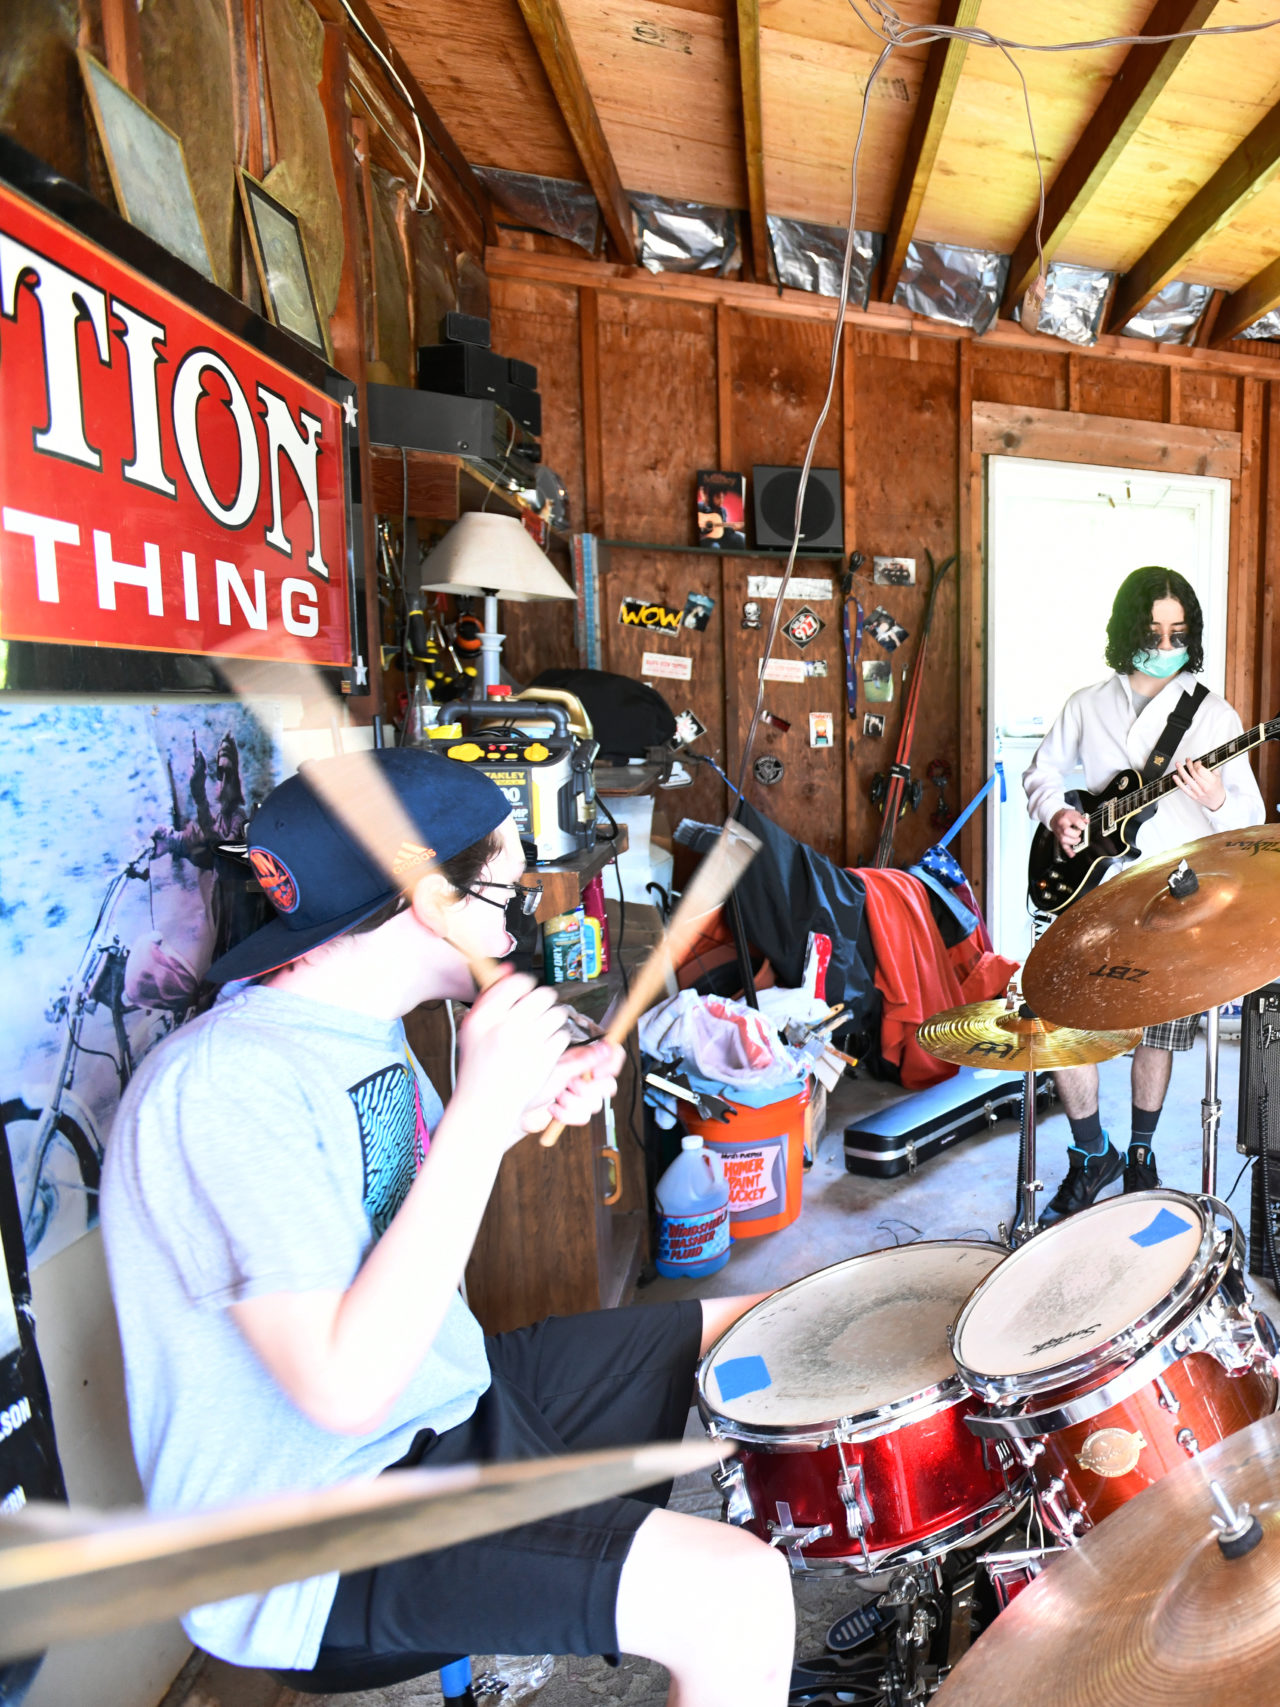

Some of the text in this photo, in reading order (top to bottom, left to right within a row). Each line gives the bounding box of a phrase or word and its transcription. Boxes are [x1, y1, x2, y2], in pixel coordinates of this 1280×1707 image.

[3, 507, 319, 638] THING
[484, 771, 525, 779] TANLEY
[392, 849, 437, 874] adidas
[1089, 964, 1150, 983] ZBT
[724, 1158, 765, 1178] HOMER
[728, 1173, 762, 1191] PAINT
[729, 1186, 767, 1203] UCKET
[669, 1230, 716, 1249] WASHER
[670, 1246, 704, 1260] FLUID
